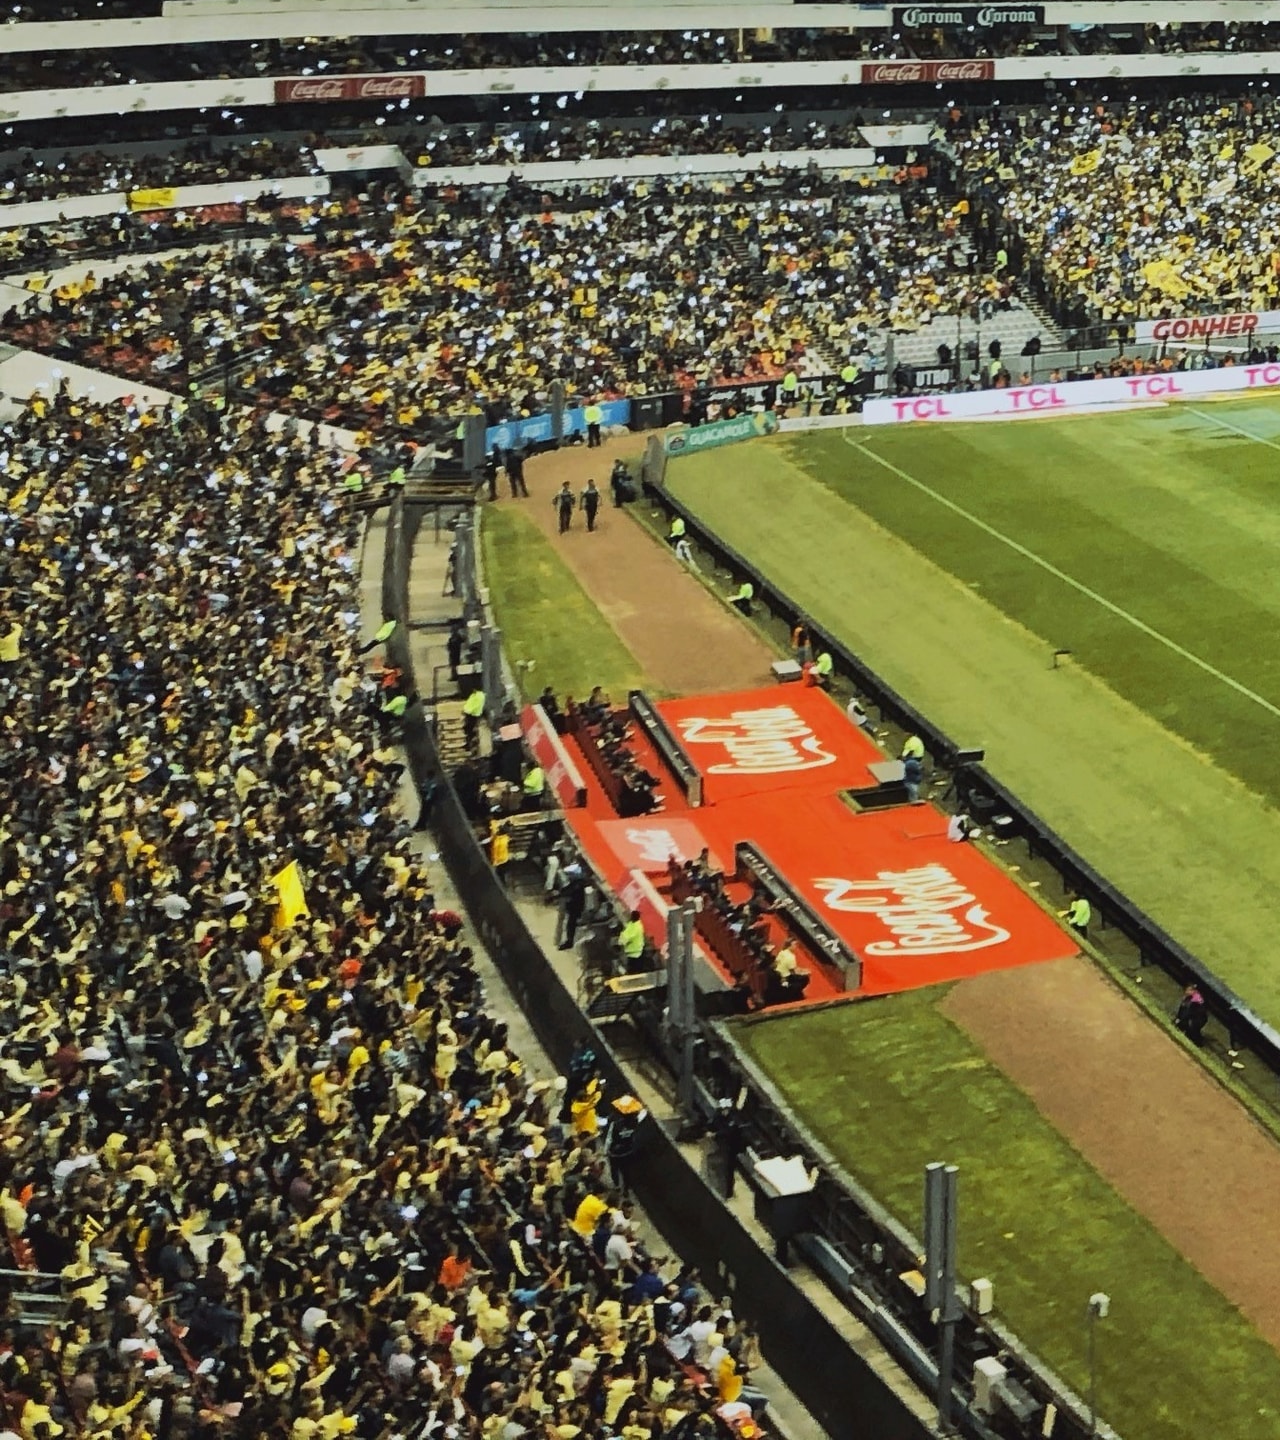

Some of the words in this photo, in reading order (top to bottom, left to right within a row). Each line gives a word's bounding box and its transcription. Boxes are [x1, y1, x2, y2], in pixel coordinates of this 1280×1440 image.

[902, 8, 963, 29] Corona
[977, 7, 1036, 28] Corona
[874, 63, 921, 81] Coca-Cola
[936, 62, 982, 80] Coca-Cola
[1153, 314, 1260, 341] GONHER
[1008, 387, 1066, 408] TCL
[1126, 377, 1183, 397] TCL
[892, 398, 952, 420] TCL
